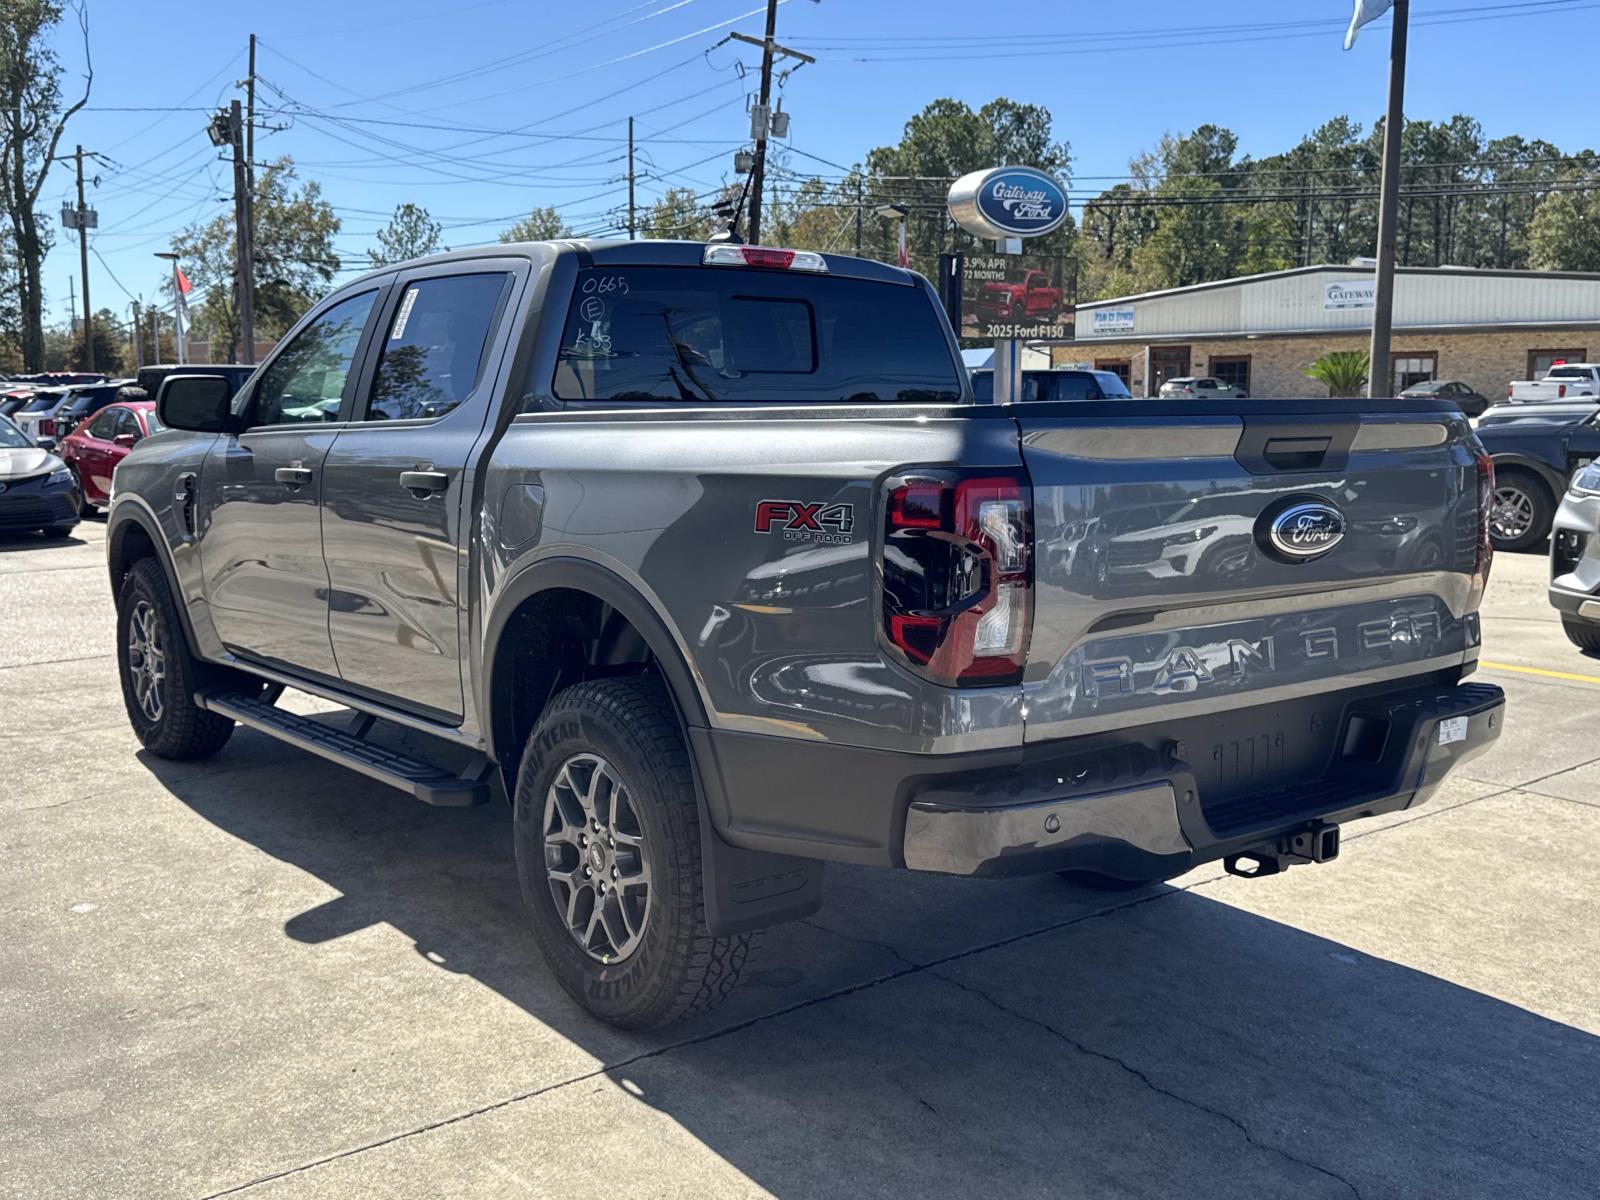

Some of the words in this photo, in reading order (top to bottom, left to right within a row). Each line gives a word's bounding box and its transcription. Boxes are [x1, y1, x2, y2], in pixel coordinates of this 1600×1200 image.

[992, 182, 1046, 203] Gateway
[1003, 200, 1052, 217] Ford
[963, 257, 986, 269] 3.9%
[987, 258, 1006, 270] APR
[963, 270, 973, 279] 72
[974, 271, 1005, 280] MONTHS
[582, 276, 629, 295] 0665
[986, 325, 1012, 337] 2025
[1014, 324, 1038, 338] Ford
[1040, 325, 1064, 338] F150
[754, 499, 855, 534] FX4
[784, 531, 811, 541] OFF
[815, 533, 852, 544] ROAD
[1292, 515, 1335, 544] Ford
[1081, 611, 1442, 699] RANGER
[518, 720, 581, 823] GOODYEAR
